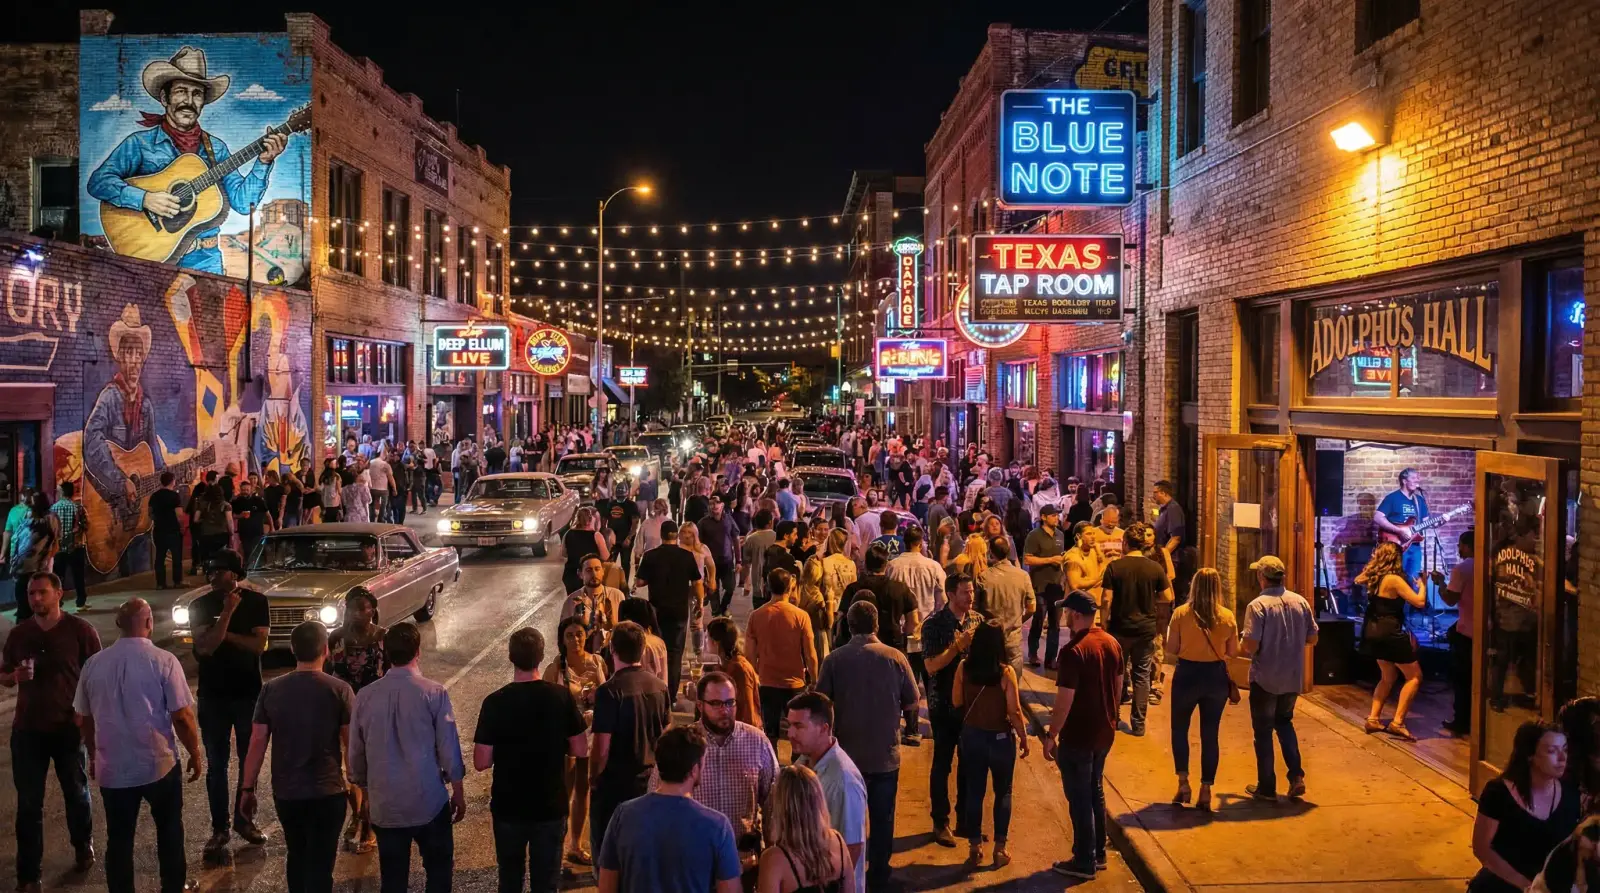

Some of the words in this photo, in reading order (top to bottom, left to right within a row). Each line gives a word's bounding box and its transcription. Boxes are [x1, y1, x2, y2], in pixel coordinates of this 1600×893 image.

[1047, 98, 1091, 115] THE
[1012, 121, 1125, 153] BLUE
[1011, 162, 1126, 195] NOTE
[993, 243, 1102, 270] TEXAS
[980, 274, 1030, 295] TAP
[1037, 274, 1115, 295] ROOM
[1024, 299, 1048, 307] TEXAS
[438, 338, 466, 351] DEEP
[468, 338, 504, 351] ELLUM
[1309, 305, 1415, 379] ADOLPHUS
[1422, 296, 1492, 372] HALL
[452, 352, 491, 365] LIVE
[1506, 563, 1526, 579] HALL
